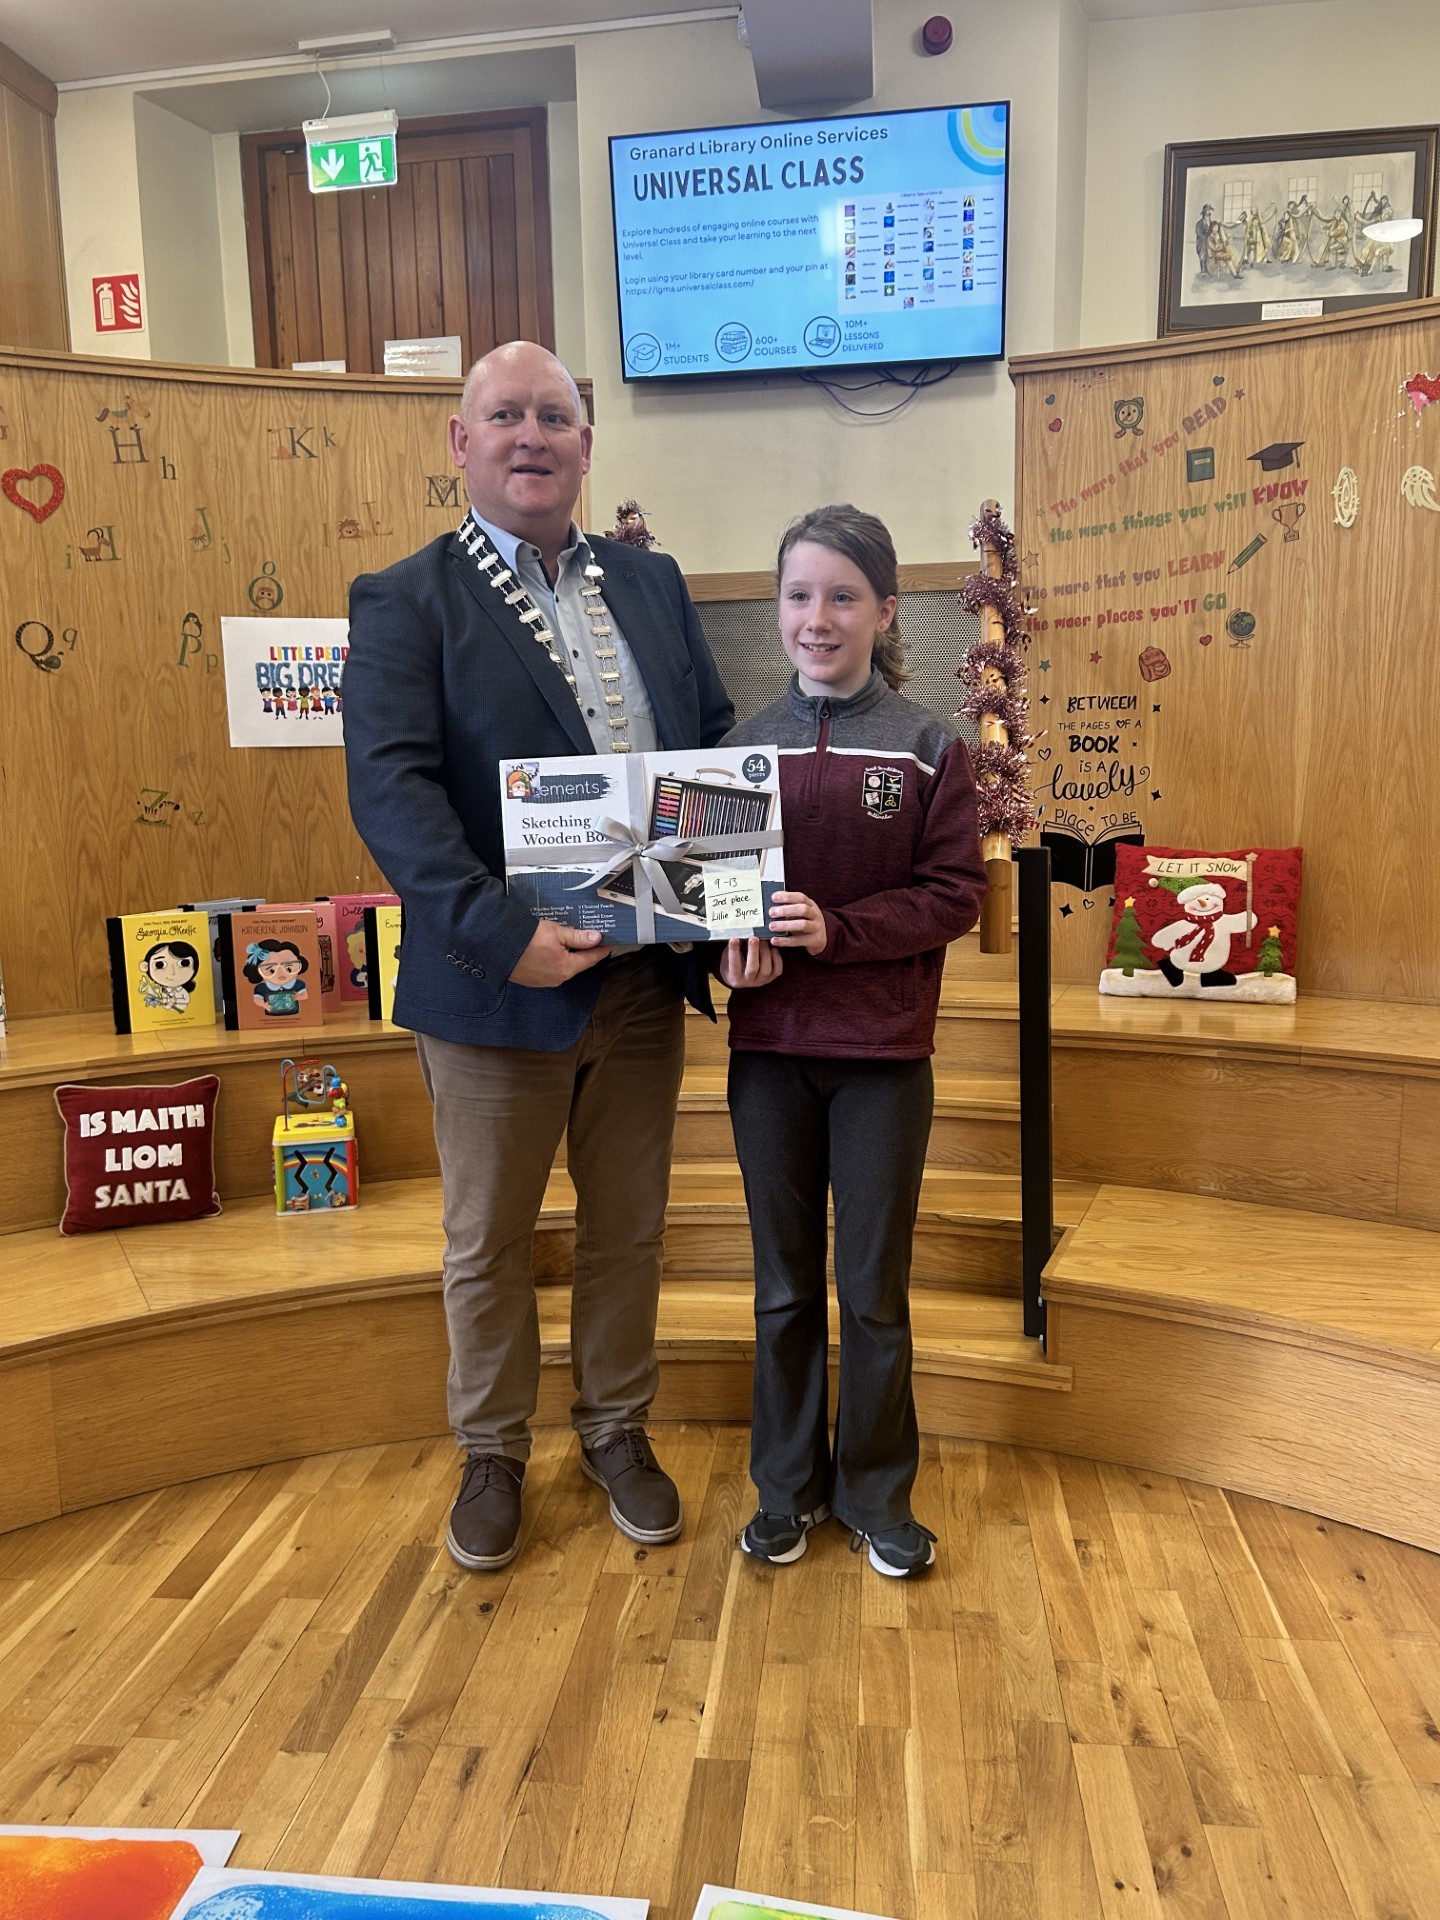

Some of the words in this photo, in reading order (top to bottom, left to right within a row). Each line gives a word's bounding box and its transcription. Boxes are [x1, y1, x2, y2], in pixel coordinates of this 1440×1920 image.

[630, 142, 695, 161] Granard
[700, 140, 756, 155] Library
[760, 132, 814, 149] Online
[817, 126, 888, 145] Services
[633, 163, 774, 202] UNIVERSAL
[781, 155, 865, 190] CLASS
[622, 228, 652, 238] Explore
[652, 224, 691, 235] hundreds
[692, 222, 701, 232] of
[702, 221, 739, 232] engaging
[741, 219, 766, 229] online
[767, 217, 800, 226] courses
[801, 214, 819, 224] with
[622, 239, 659, 249] Universal
[660, 238, 681, 247] Class
[682, 236, 698, 245] and
[699, 235, 717, 244] take
[719, 233, 737, 243] your
[738, 231, 771, 240] learning
[772, 230, 781, 238] to
[783, 229, 797, 237] the
[798, 227, 817, 236] next
[623, 252, 644, 261] level.
[625, 275, 647, 286] Login
[647, 274, 669, 284] using
[670, 273, 688, 283] your
[689, 270, 715, 280] library
[715, 269, 735, 278] card
[735, 267, 767, 277] number
[769, 265, 784, 274] and
[785, 264, 804, 275] your
[805, 263, 818, 273] pin
[819, 262, 829, 270] at
[845, 320, 868, 329] 10M+
[755, 336, 778, 345] 600+
[844, 331, 880, 341] LESSONS
[665, 342, 681, 350] 1M+
[754, 345, 798, 356] COURSES
[842, 342, 884, 352] DELIVERED
[663, 354, 710, 365] STUDENTS
[286, 426, 318, 459] K
[1050, 498, 1078, 519] The
[1080, 474, 1116, 502] more
[1118, 448, 1149, 477] that
[1152, 430, 1180, 457] you
[1181, 396, 1227, 435] READ
[160, 455, 177, 480] h
[1050, 527, 1074, 544] the
[1079, 521, 1117, 538] more
[1122, 511, 1172, 532] things
[1178, 503, 1208, 523] you
[1214, 492, 1247, 513] will
[1252, 479, 1309, 506] KNOW
[1053, 581, 1090, 597] more
[1095, 570, 1126, 590] that
[1132, 567, 1161, 586] you
[1167, 550, 1226, 578] LEARN
[1025, 617, 1049, 632] the
[1096, 608, 1144, 629] places
[1202, 591, 1228, 613] GO
[269, 646, 314, 662] LITTLE
[255, 662, 293, 689] BIG
[298, 662, 345, 689] DRE
[1066, 695, 1138, 713] BETWEEN
[1058, 722, 1076, 731] THE
[1080, 721, 1111, 730] PAGES
[1134, 719, 1142, 729] A
[1068, 734, 1120, 754] BOOK
[746, 758, 766, 773] 54
[1096, 760, 1107, 773] A
[1034, 760, 1151, 801] lovely
[522, 814, 592, 830] Sketching
[1101, 813, 1118, 828] TO
[1122, 811, 1138, 824] BE
[523, 831, 582, 846] Wooden
[1157, 861, 1184, 874] LET
[1190, 863, 1200, 874] IT
[1206, 862, 1242, 874] SNOW
[712, 897, 727, 908] 2nd
[731, 894, 751, 906] place
[735, 907, 760, 920] Byrne
[136, 927, 168, 941] Georgia
[241, 925, 277, 935] KATHERINE
[279, 924, 309, 934] JOHNSON
[79, 1111, 107, 1138] IS
[111, 1104, 205, 1134] MAITH
[105, 1143, 183, 1173] LIOM
[94, 1178, 191, 1210] SANTA
